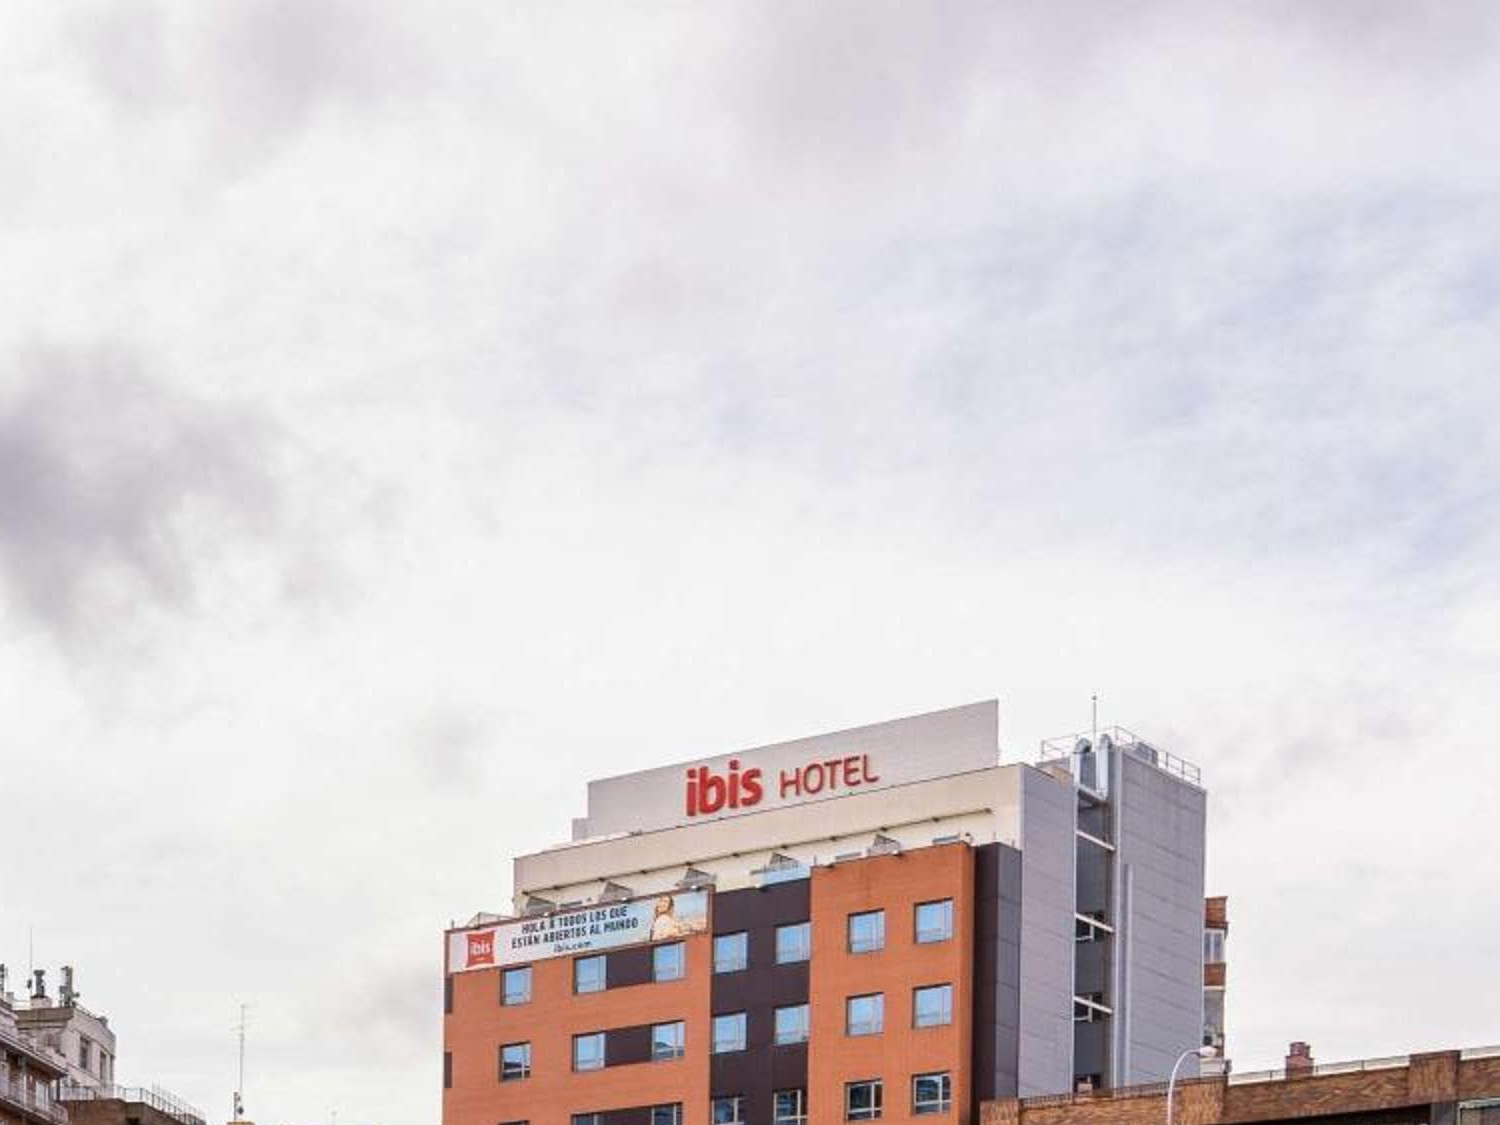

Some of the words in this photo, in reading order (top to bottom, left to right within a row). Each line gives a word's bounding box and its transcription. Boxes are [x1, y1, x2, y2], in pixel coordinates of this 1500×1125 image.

[685, 759, 764, 817] ibis
[779, 754, 880, 799] HOTEL
[520, 921, 547, 935] HOLA
[556, 914, 587, 929] TODOS
[589, 910, 608, 923] LOS
[609, 905, 629, 919] QUE
[542, 927, 587, 944] ABIERTOS
[589, 923, 602, 936] AL
[603, 916, 639, 933] MUNDO
